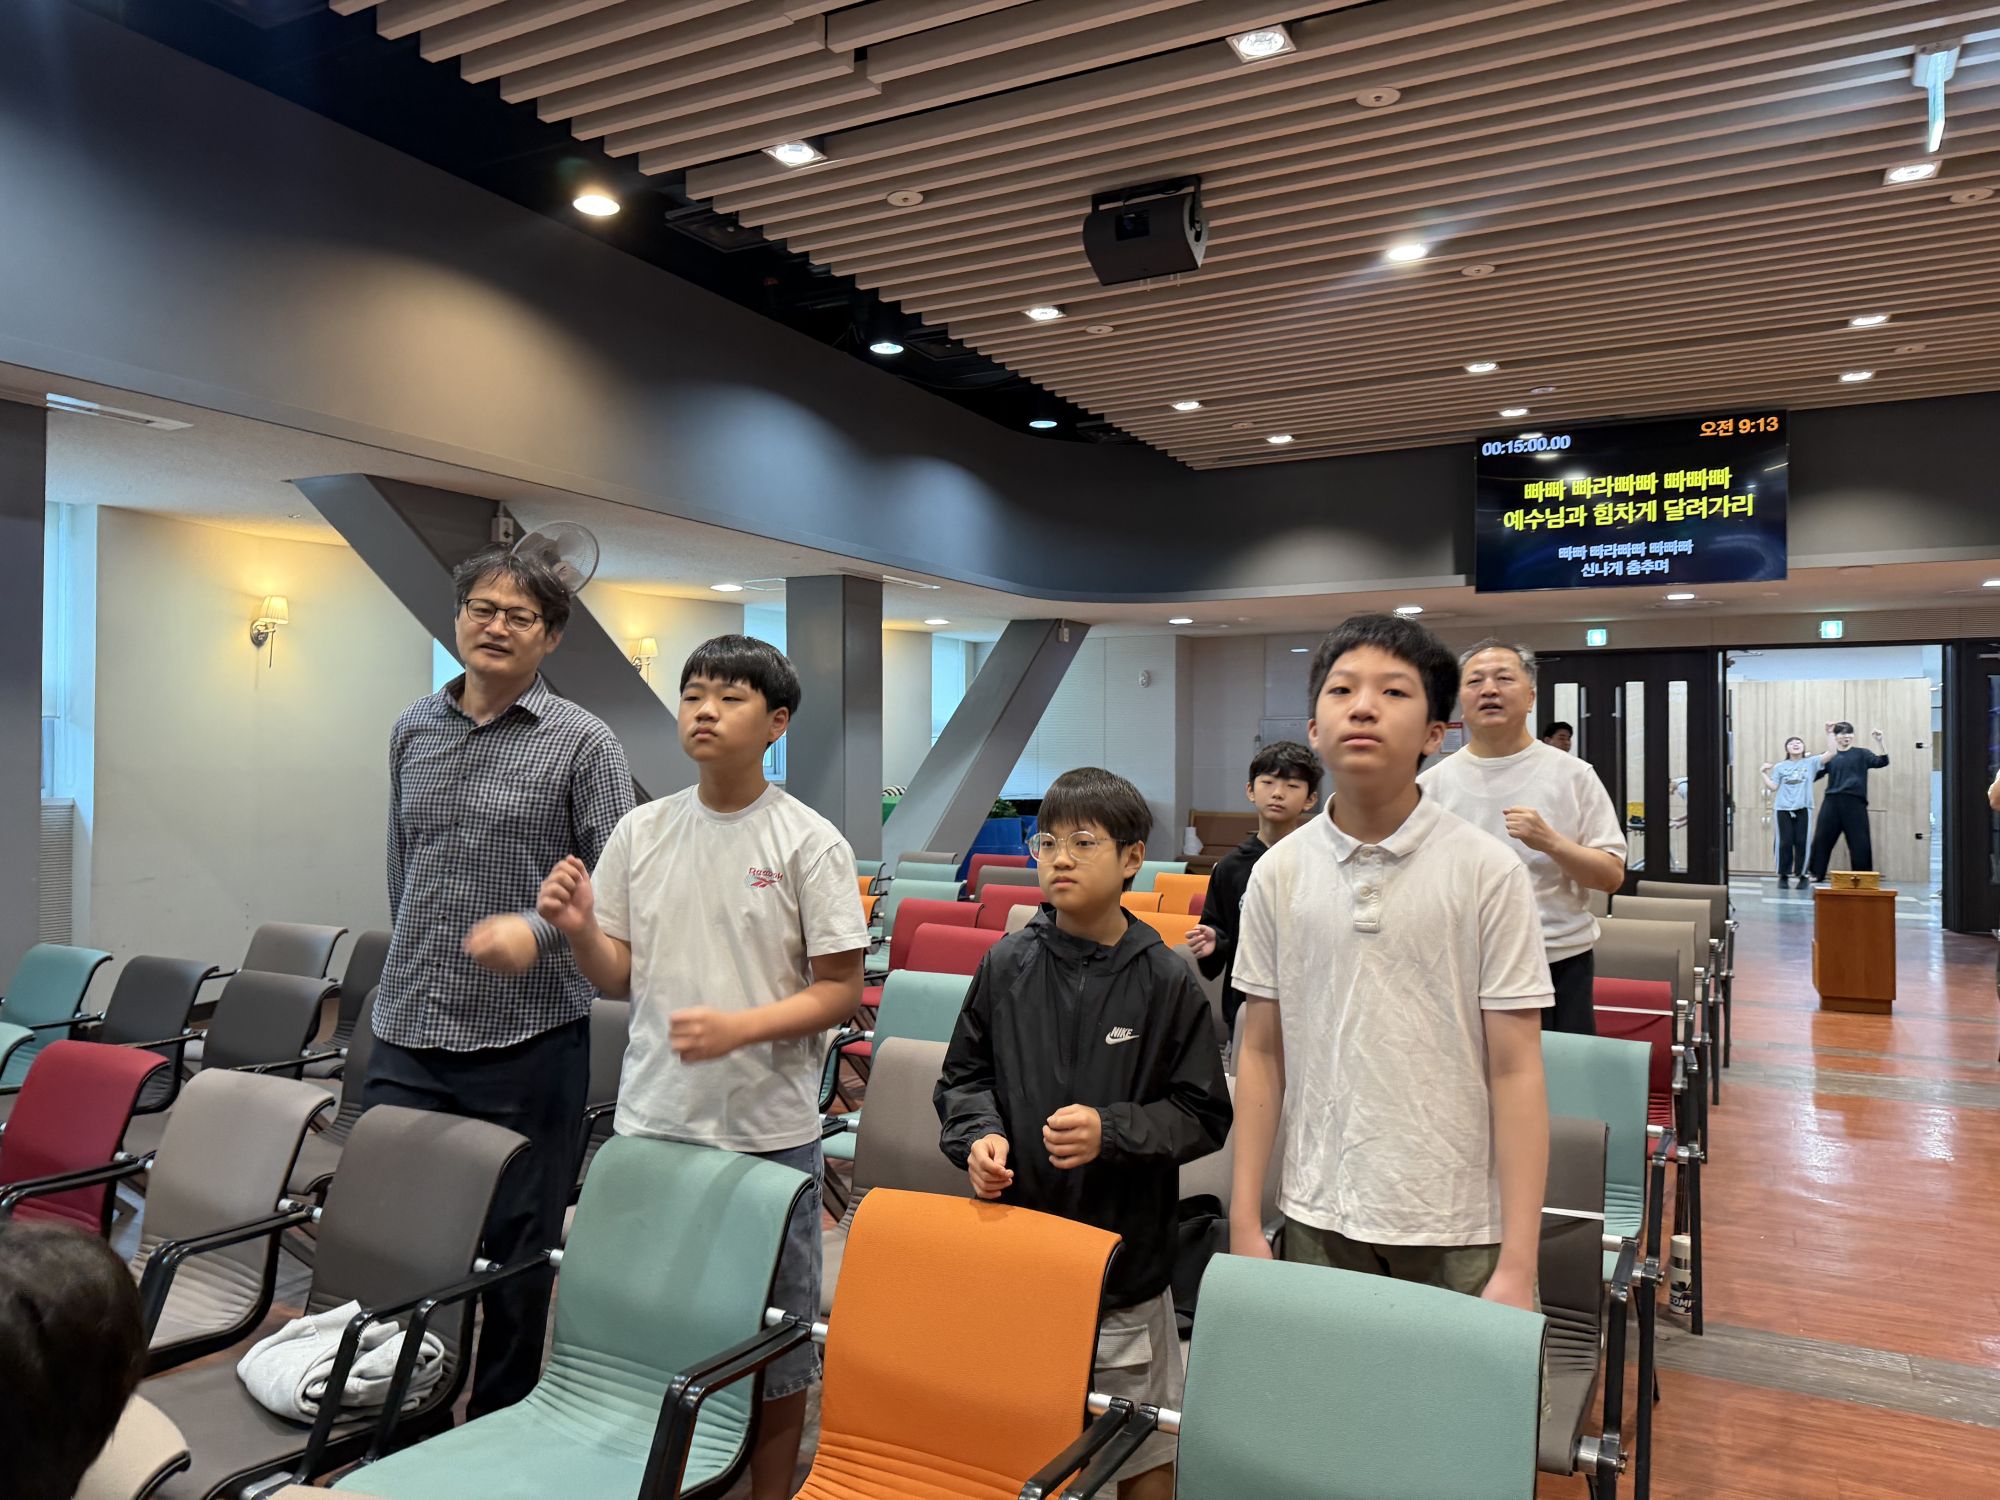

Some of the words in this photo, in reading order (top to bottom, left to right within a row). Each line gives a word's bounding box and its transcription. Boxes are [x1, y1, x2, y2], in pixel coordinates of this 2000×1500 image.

[1699, 418, 1734, 437] 오전
[1738, 416, 1779, 434] 9:13
[1482, 434, 1572, 456] 00:15:00.00
[1524, 480, 1567, 503] 빠빠
[1572, 472, 1660, 500] 빠라빠빠
[1664, 466, 1733, 493] 빠빠빠
[1503, 504, 1588, 531] 예수님과
[1592, 500, 1657, 526] 힘차게
[1663, 493, 1754, 520] 달려가리
[1558, 545, 1588, 561] 빠빠
[1589, 542, 1647, 559] 빠라빠빠
[1649, 539, 1694, 556] 빠빠빠
[1581, 560, 1624, 577] 신나게
[1626, 558, 1669, 576] 춤추며
[1110, 1026, 1133, 1038] NIKE
